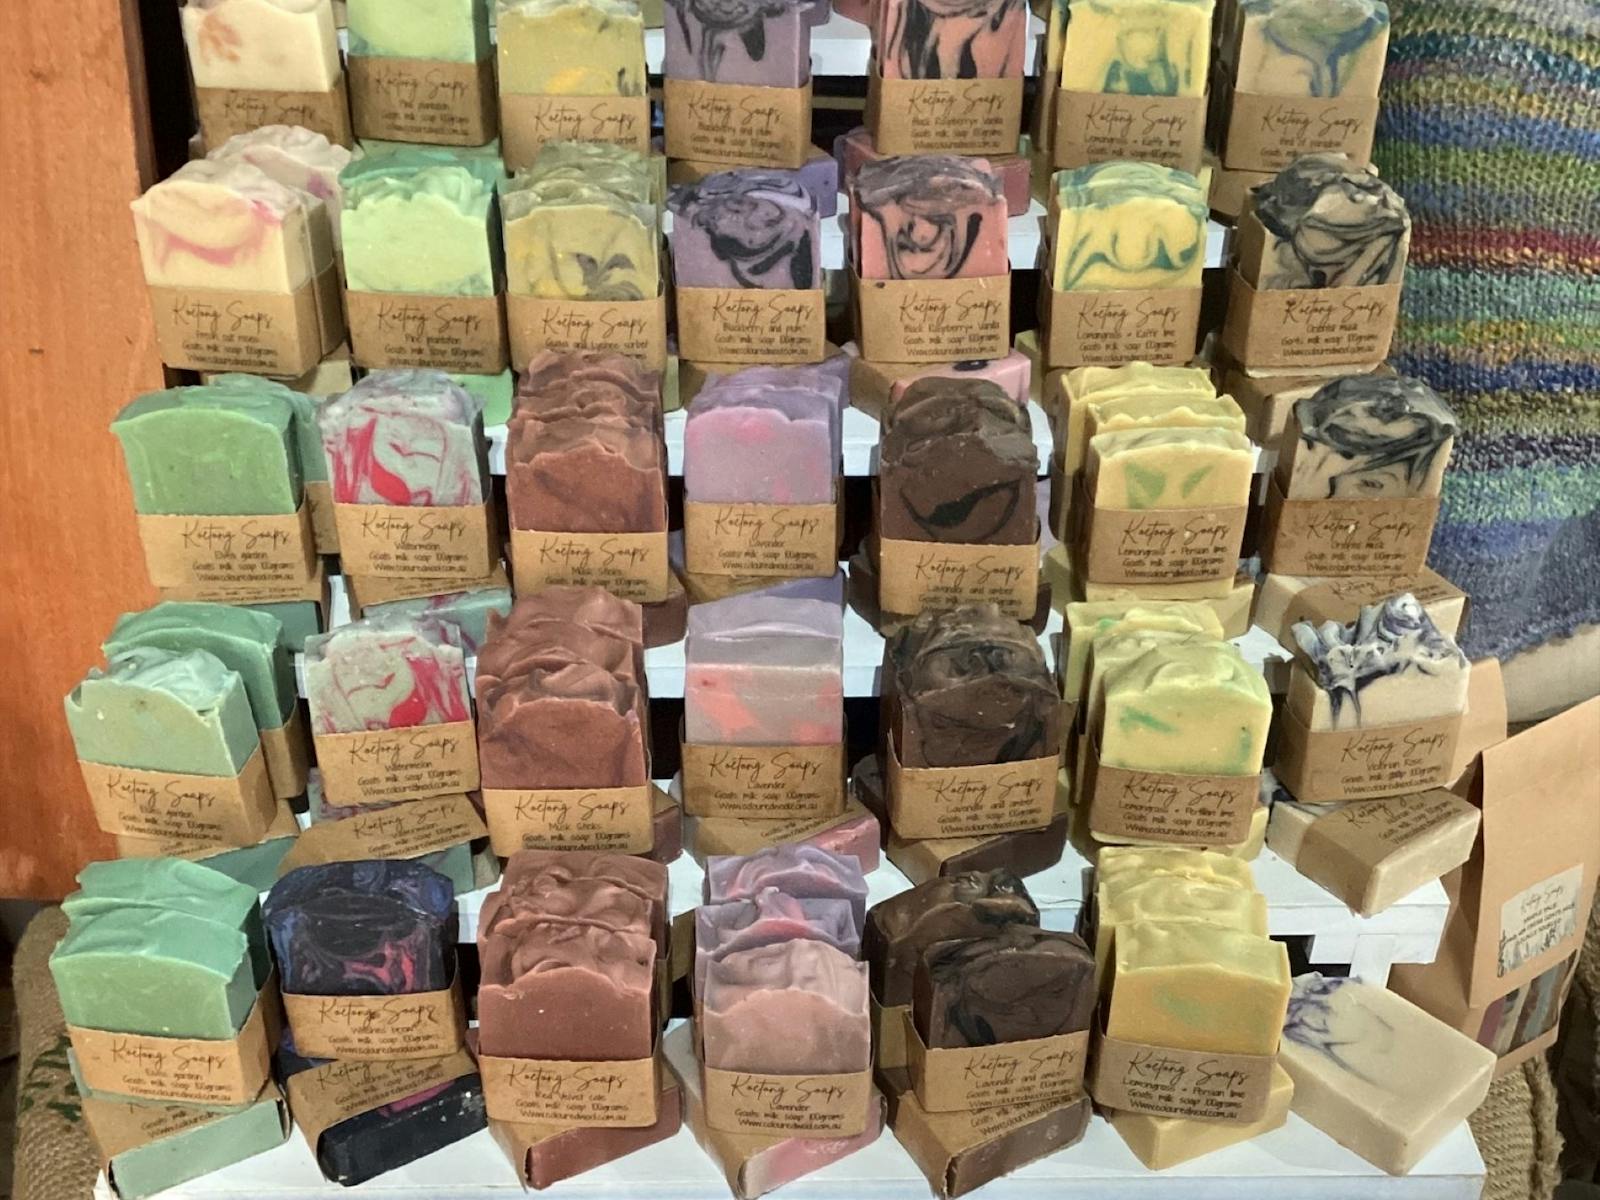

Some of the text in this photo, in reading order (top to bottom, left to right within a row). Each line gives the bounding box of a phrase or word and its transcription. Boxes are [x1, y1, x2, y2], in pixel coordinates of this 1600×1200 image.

[590, 103, 636, 134] Soaps
[435, 303, 480, 335] Soaps
[769, 294, 814, 324] Soaps
[955, 290, 1002, 321] Soaps
[1136, 297, 1181, 328] Soaps
[1342, 292, 1388, 323] Soaps
[600, 308, 647, 339] Soaps
[240, 519, 290, 550] Soaps
[418, 512, 466, 542] Soaps
[771, 508, 820, 536] Soaps
[1183, 516, 1231, 546] Soaps
[600, 537, 650, 567] Soaps
[976, 554, 1024, 586] Soaps
[410, 730, 460, 760] Soaps
[1403, 727, 1448, 757] Soaps
[771, 752, 823, 781] Soaps
[164, 780, 215, 811] Soaps
[997, 771, 1042, 800] Soaps
[1189, 779, 1241, 809] Soaps
[577, 792, 630, 821] Soaps
[383, 997, 437, 1025] Soaps
[172, 1044, 226, 1074] Soaps
[1029, 1045, 1079, 1074] Soaps
[573, 1065, 628, 1093] Soaps
[1195, 1060, 1249, 1090] Soaps
[795, 1077, 847, 1104] Soaps
